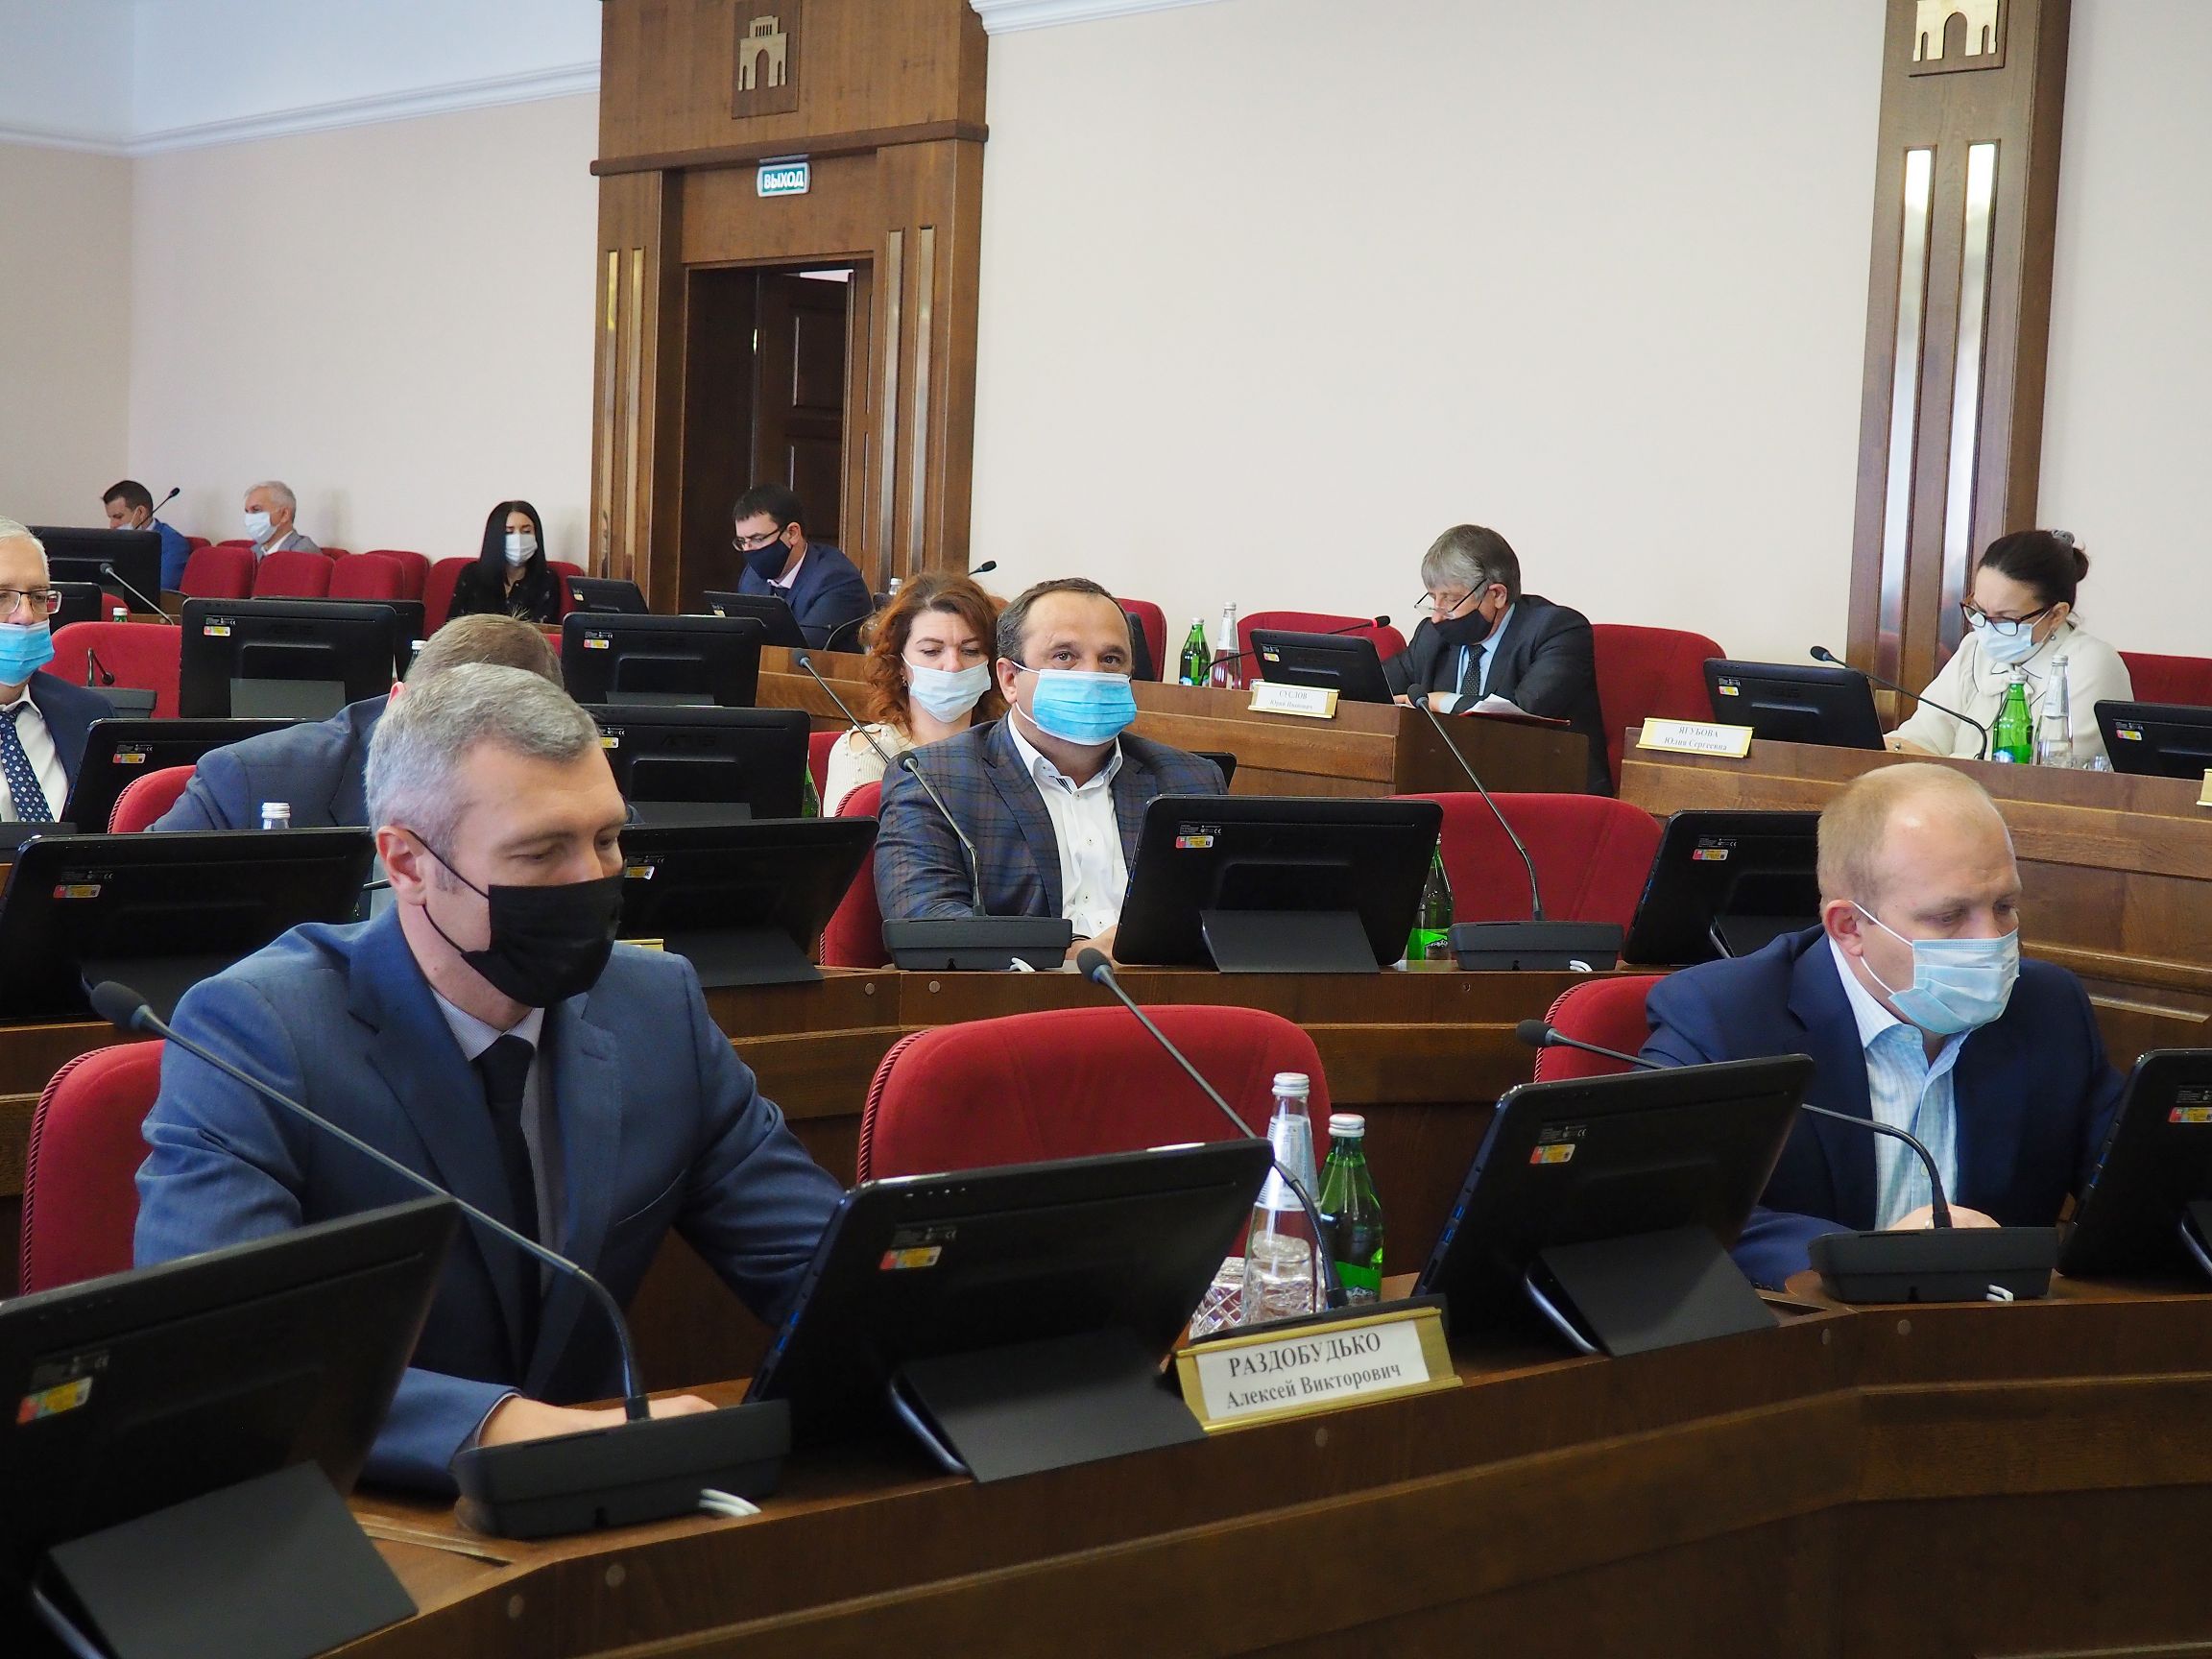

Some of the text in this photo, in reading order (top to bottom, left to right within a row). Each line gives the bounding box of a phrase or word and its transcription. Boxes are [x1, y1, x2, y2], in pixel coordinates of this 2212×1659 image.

[764, 170, 805, 189] ВЫХОД
[1228, 1332, 1382, 1378] РАЗДОБУДЬКО
[1226, 1362, 1402, 1409] Алексей Викторович
